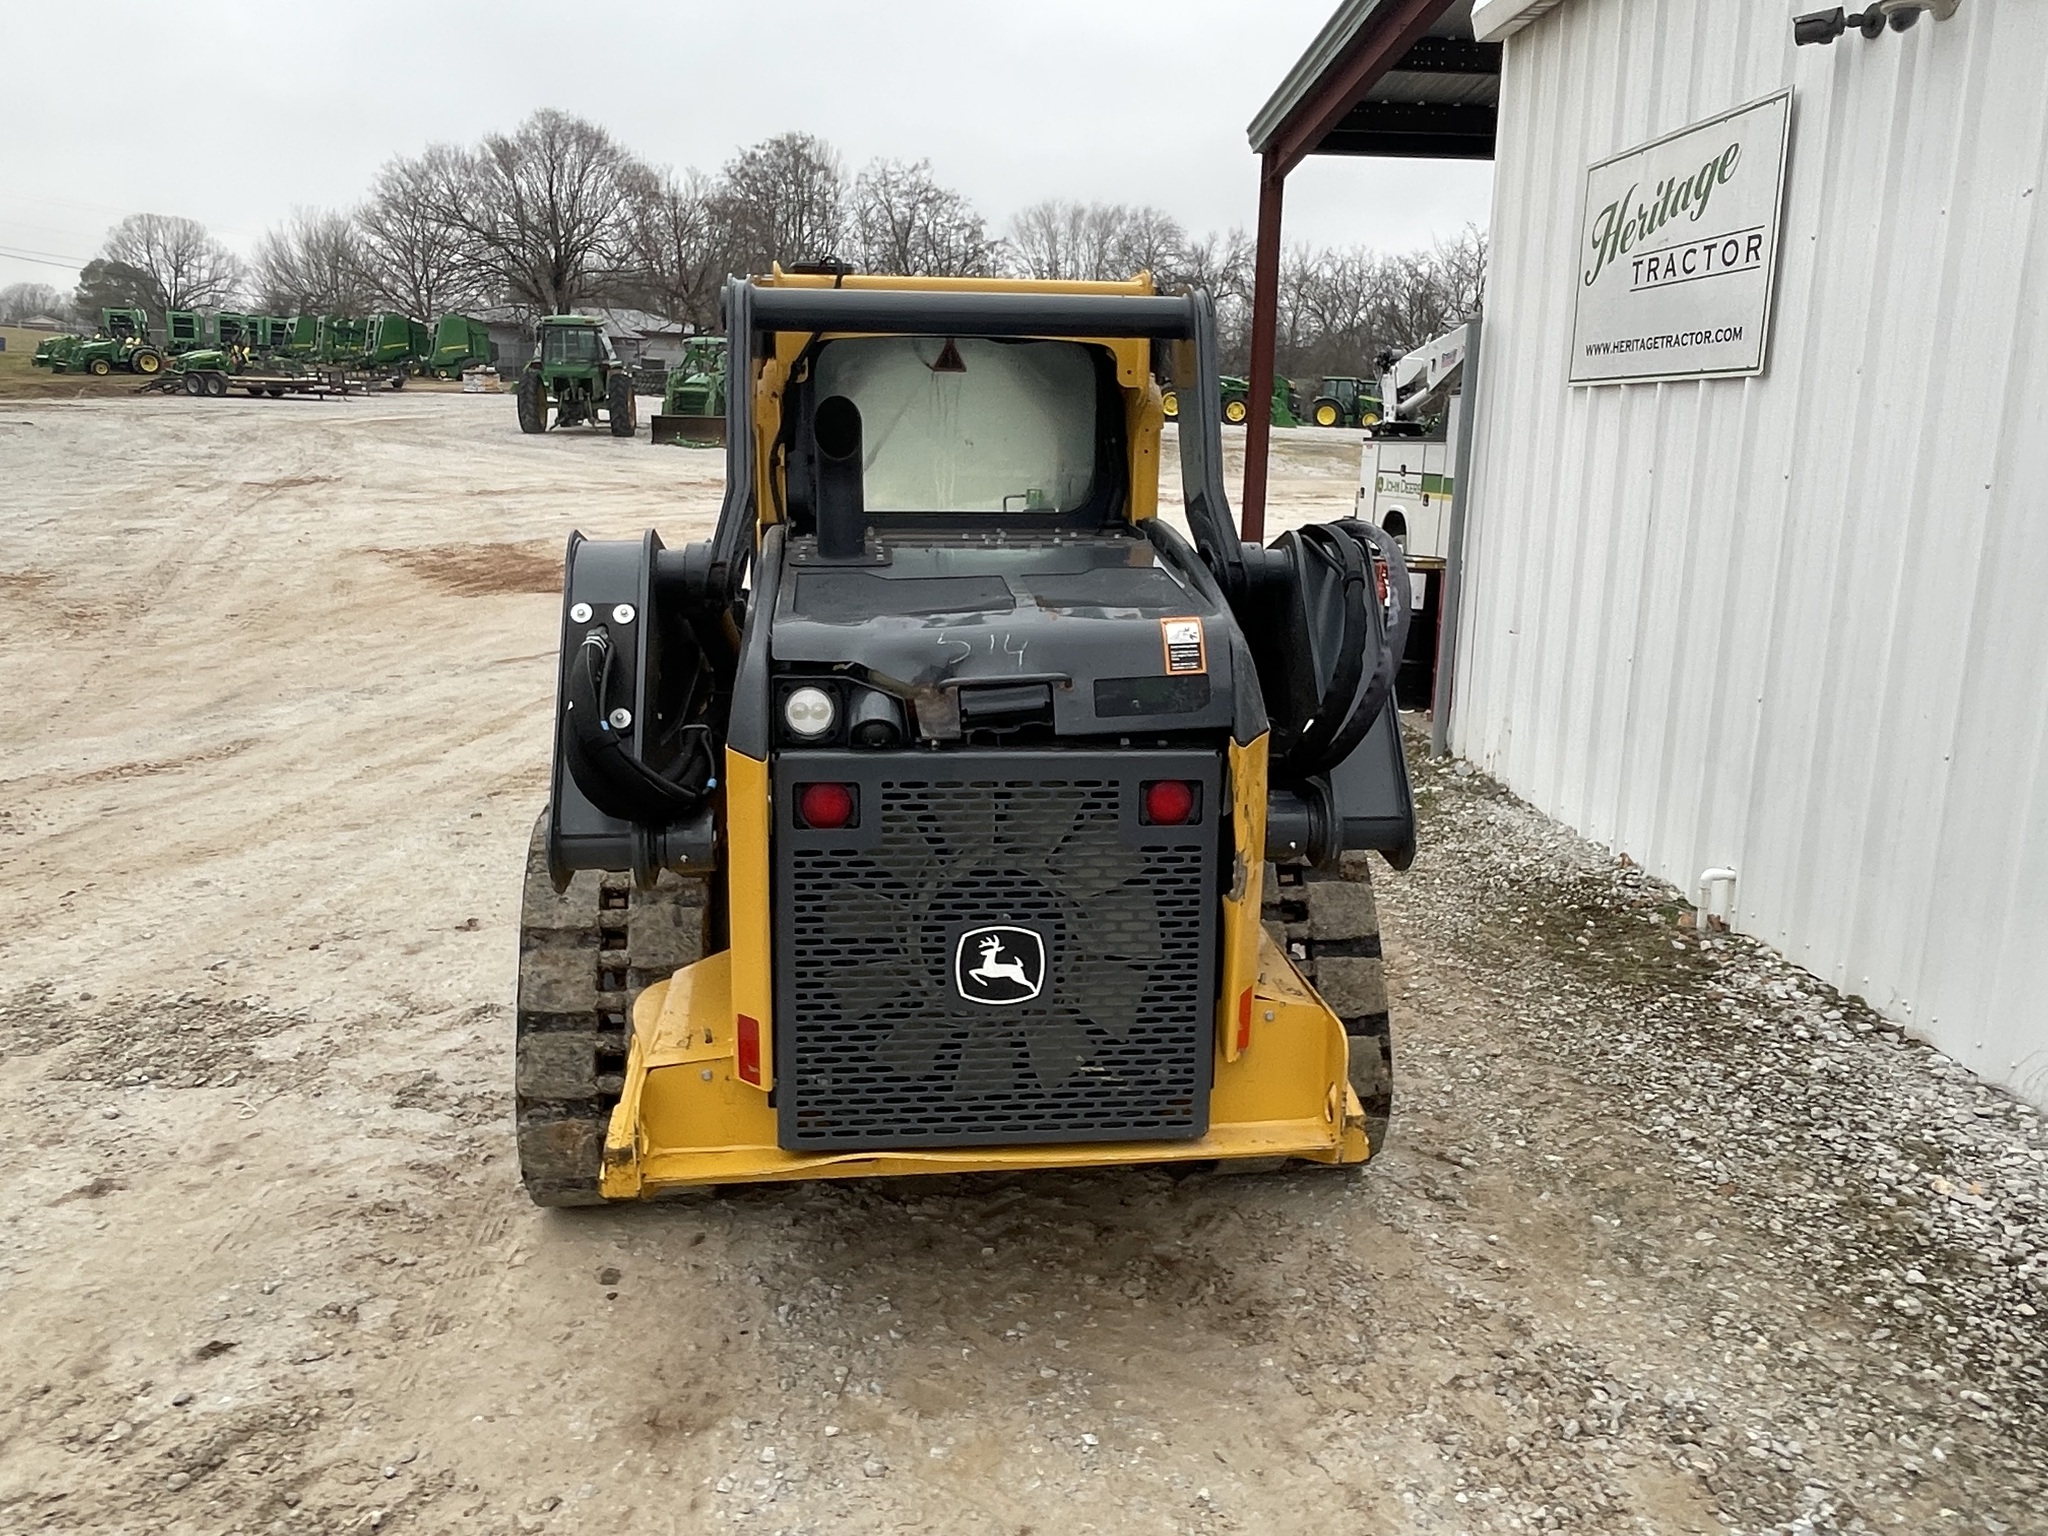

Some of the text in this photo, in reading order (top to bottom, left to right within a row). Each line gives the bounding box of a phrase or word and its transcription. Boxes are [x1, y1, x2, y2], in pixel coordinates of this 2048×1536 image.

[1585, 142, 1740, 287] Heritage
[1632, 233, 1763, 285] TRACTOR
[1585, 326, 1743, 357] WWW.HERITAGETRACTOR.COM
[937, 632, 1028, 669] 514
